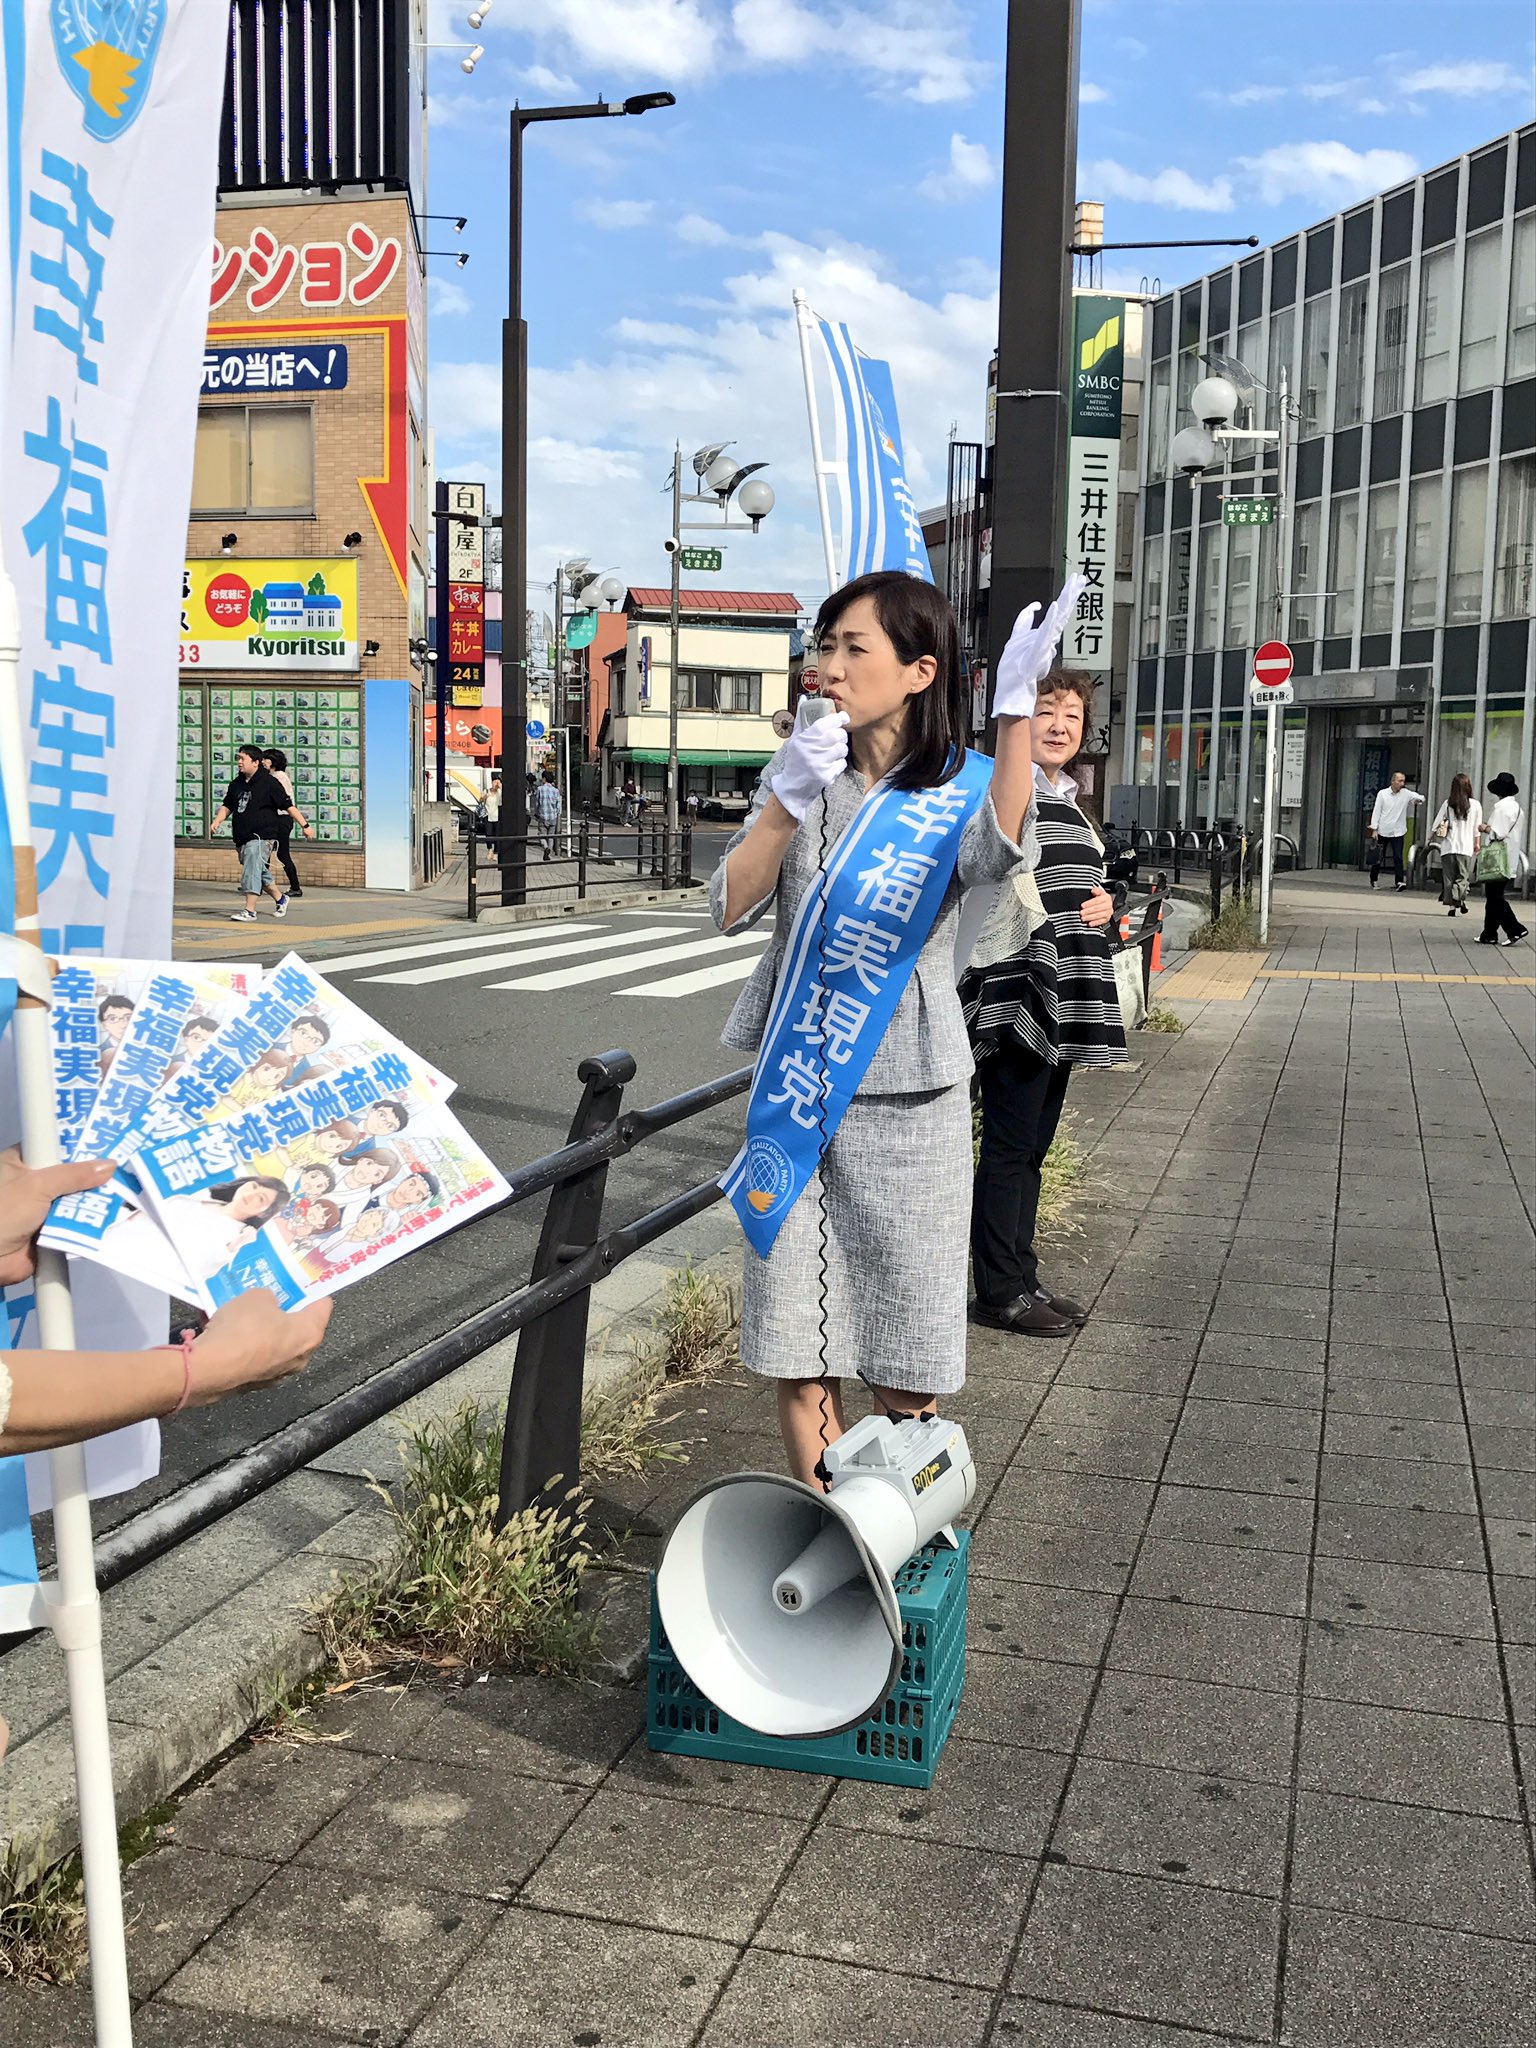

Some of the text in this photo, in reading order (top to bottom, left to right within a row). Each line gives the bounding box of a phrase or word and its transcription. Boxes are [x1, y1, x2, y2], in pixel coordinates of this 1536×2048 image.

[1077, 374, 1120, 390] SMBC
[1080, 410, 1115, 418] CORPORATION
[1227, 512, 1269, 523] えきまえ
[22, 147, 117, 953] 幸福実
[1074, 453, 1109, 655] 三井住友銀行
[459, 568, 473, 578] 2F
[210, 589, 247, 600] お気軽に
[215, 603, 243, 614] どうぞ
[452, 619, 480, 637] 牛丼
[248, 637, 345, 657] Kyoritsu
[452, 639, 482, 655] カレー
[767, 782, 971, 1130] 幸福実現党
[779, 1169, 789, 1193] PARTY
